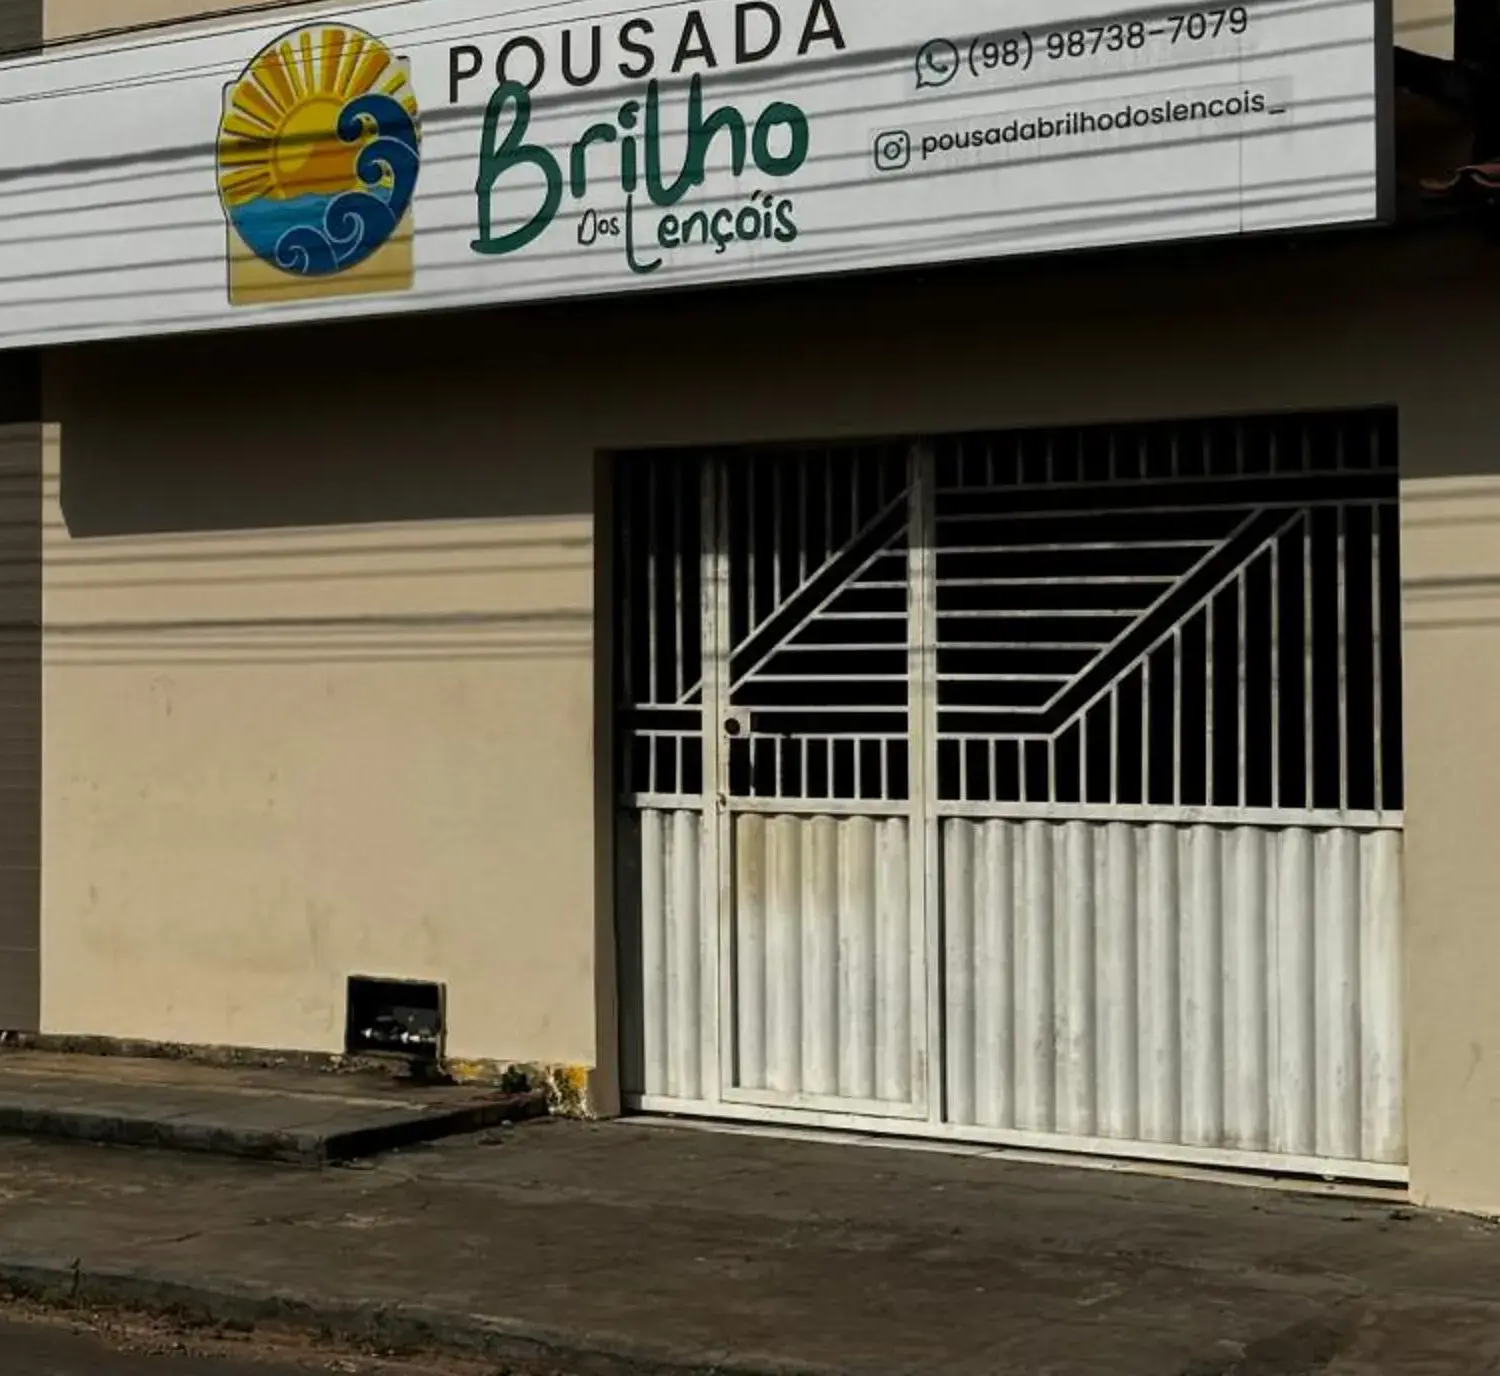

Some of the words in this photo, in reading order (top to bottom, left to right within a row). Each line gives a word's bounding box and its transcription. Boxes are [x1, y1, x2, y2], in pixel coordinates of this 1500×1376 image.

[968, 31, 1034, 77] (98)
[1046, 5, 1249, 60] 98738-7079
[470, 72, 810, 255] Brilho
[921, 89, 1286, 160] pousadabrilhodoslencois_
[626, 189, 799, 274] Lençóis
